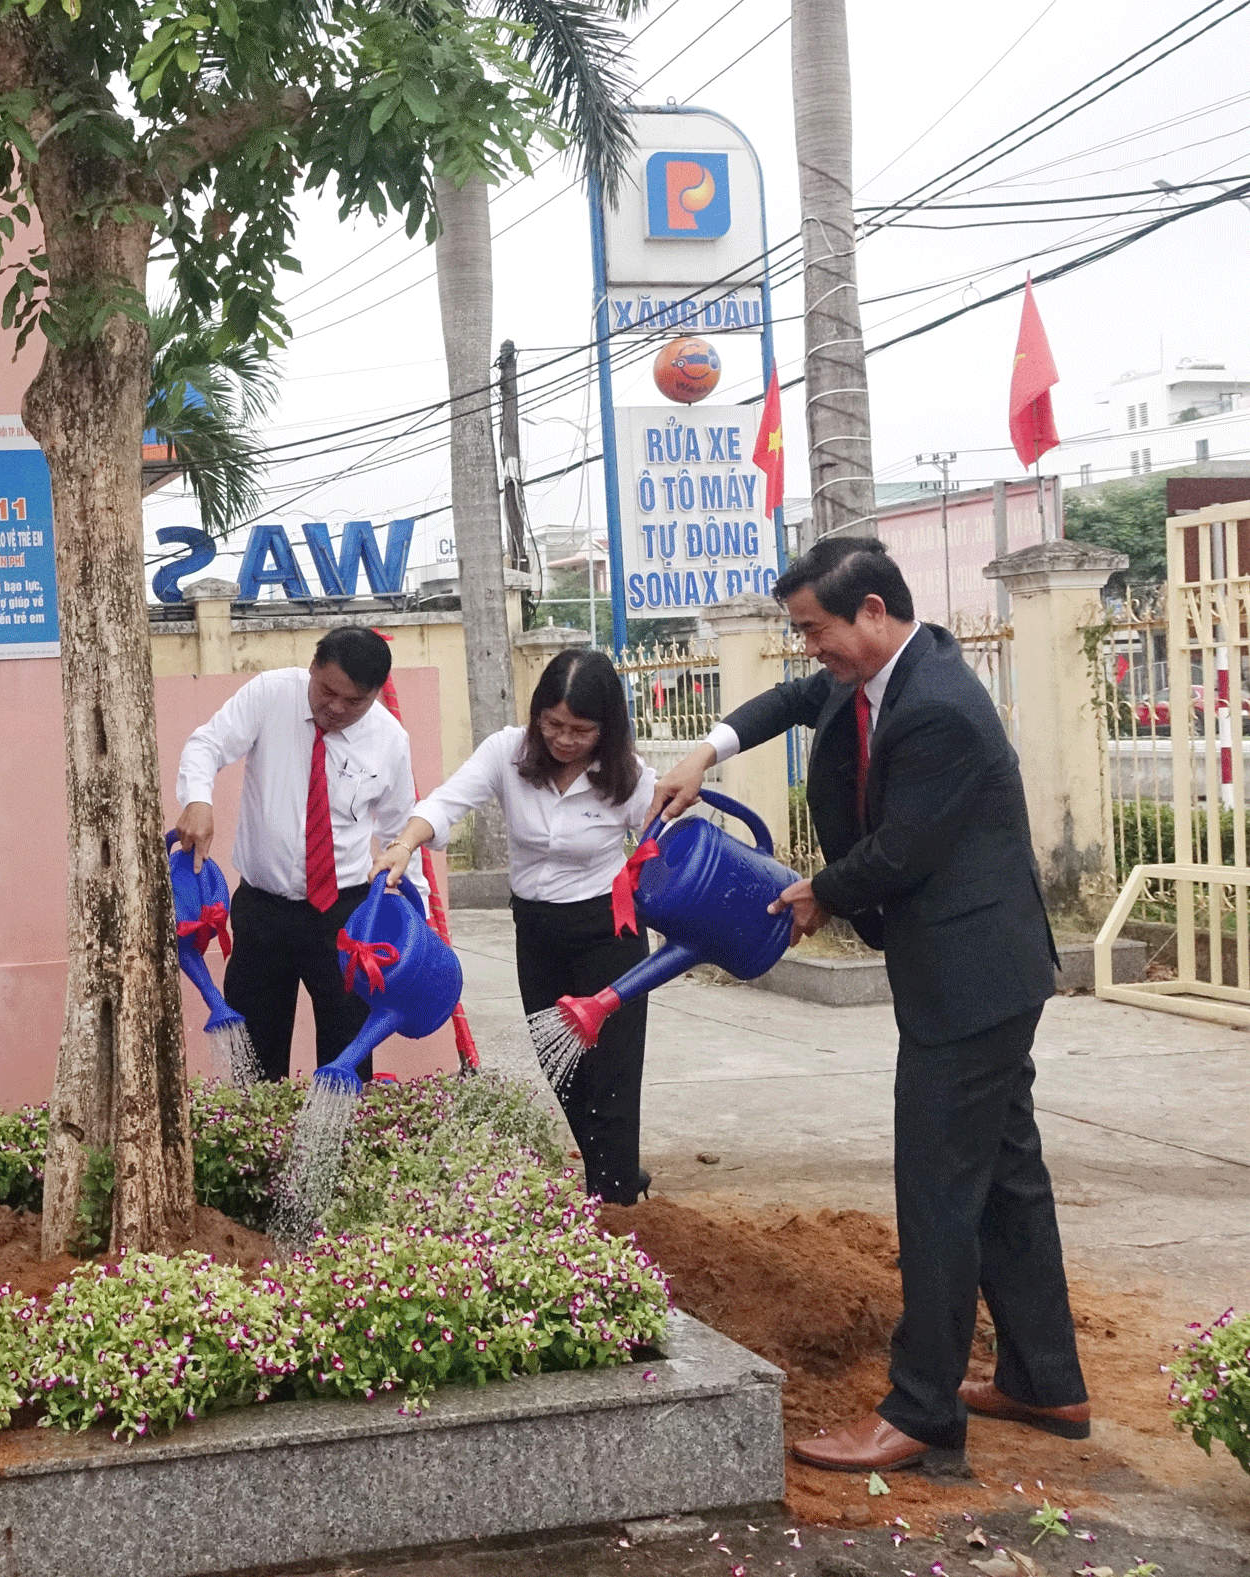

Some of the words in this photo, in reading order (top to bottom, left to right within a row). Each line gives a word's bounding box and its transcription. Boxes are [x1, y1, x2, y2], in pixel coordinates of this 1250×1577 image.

[613, 294, 701, 330] XĂNG
[703, 292, 760, 329] DẦU
[647, 416, 701, 463] RỬA
[709, 427, 742, 462] XE
[638, 467, 656, 513] Ô
[661, 465, 700, 509] TÔ
[700, 467, 756, 507] MÁY
[6, 528, 16, 551] VỆ
[17, 525, 31, 548] TRẺ
[32, 530, 42, 547] EM
[642, 524, 676, 568] TỰ
[686, 515, 759, 568] ĐỘNG
[8, 552, 25, 568] PHÍ
[3, 580, 21, 593] bạo
[24, 579, 43, 593] lực,
[628, 571, 720, 609] SONAX
[8, 596, 29, 609] giúp
[32, 596, 43, 608] về
[13, 611, 26, 625] trẻ
[29, 613, 44, 624] em
